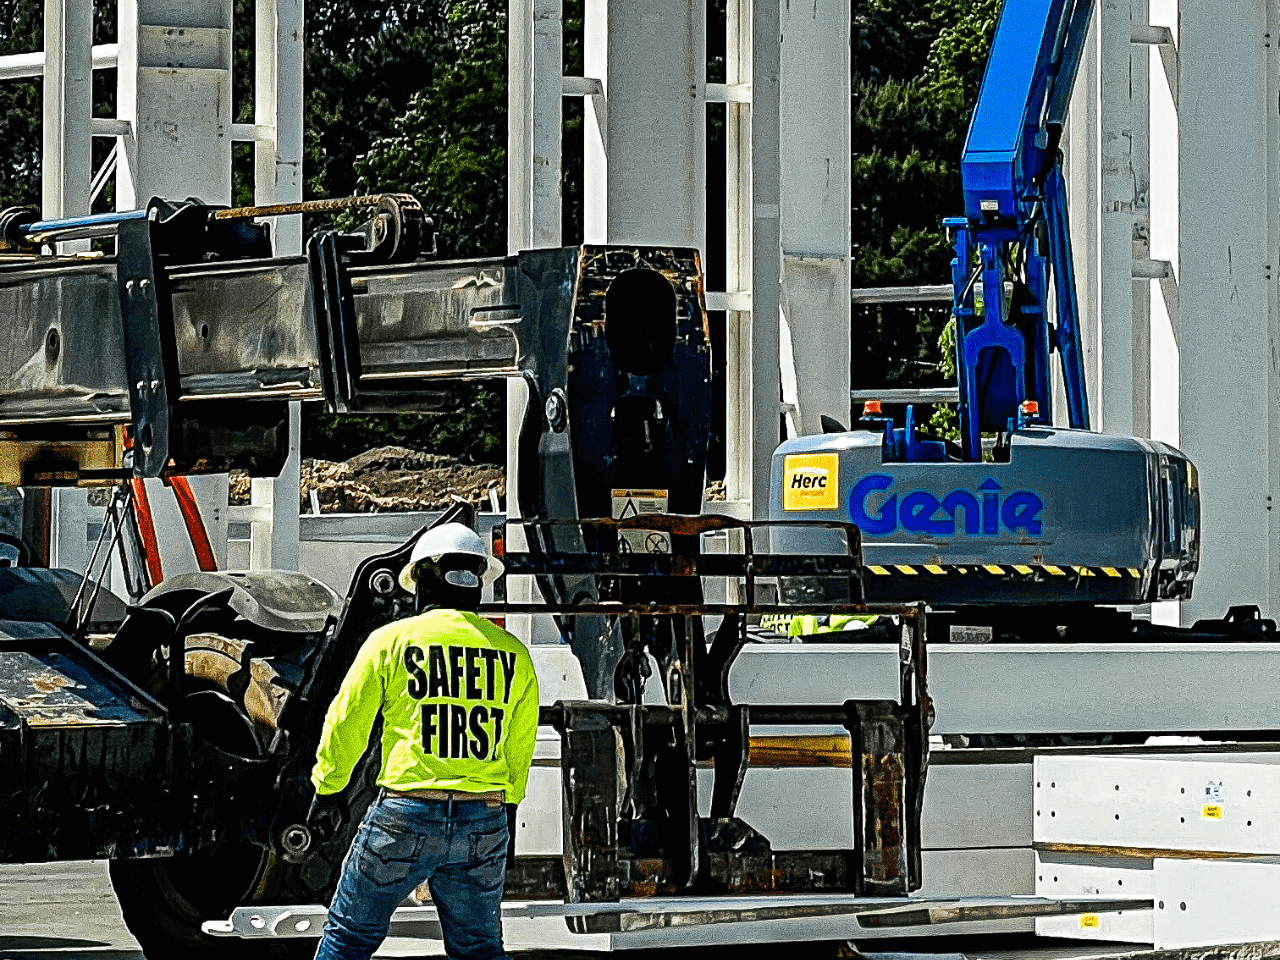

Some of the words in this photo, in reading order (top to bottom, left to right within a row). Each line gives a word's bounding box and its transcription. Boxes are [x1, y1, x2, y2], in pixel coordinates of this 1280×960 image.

[791, 473, 828, 489] Herc
[848, 472, 1044, 536] Genie
[404, 644, 517, 705] SAFETY
[421, 703, 504, 761] FIRST
